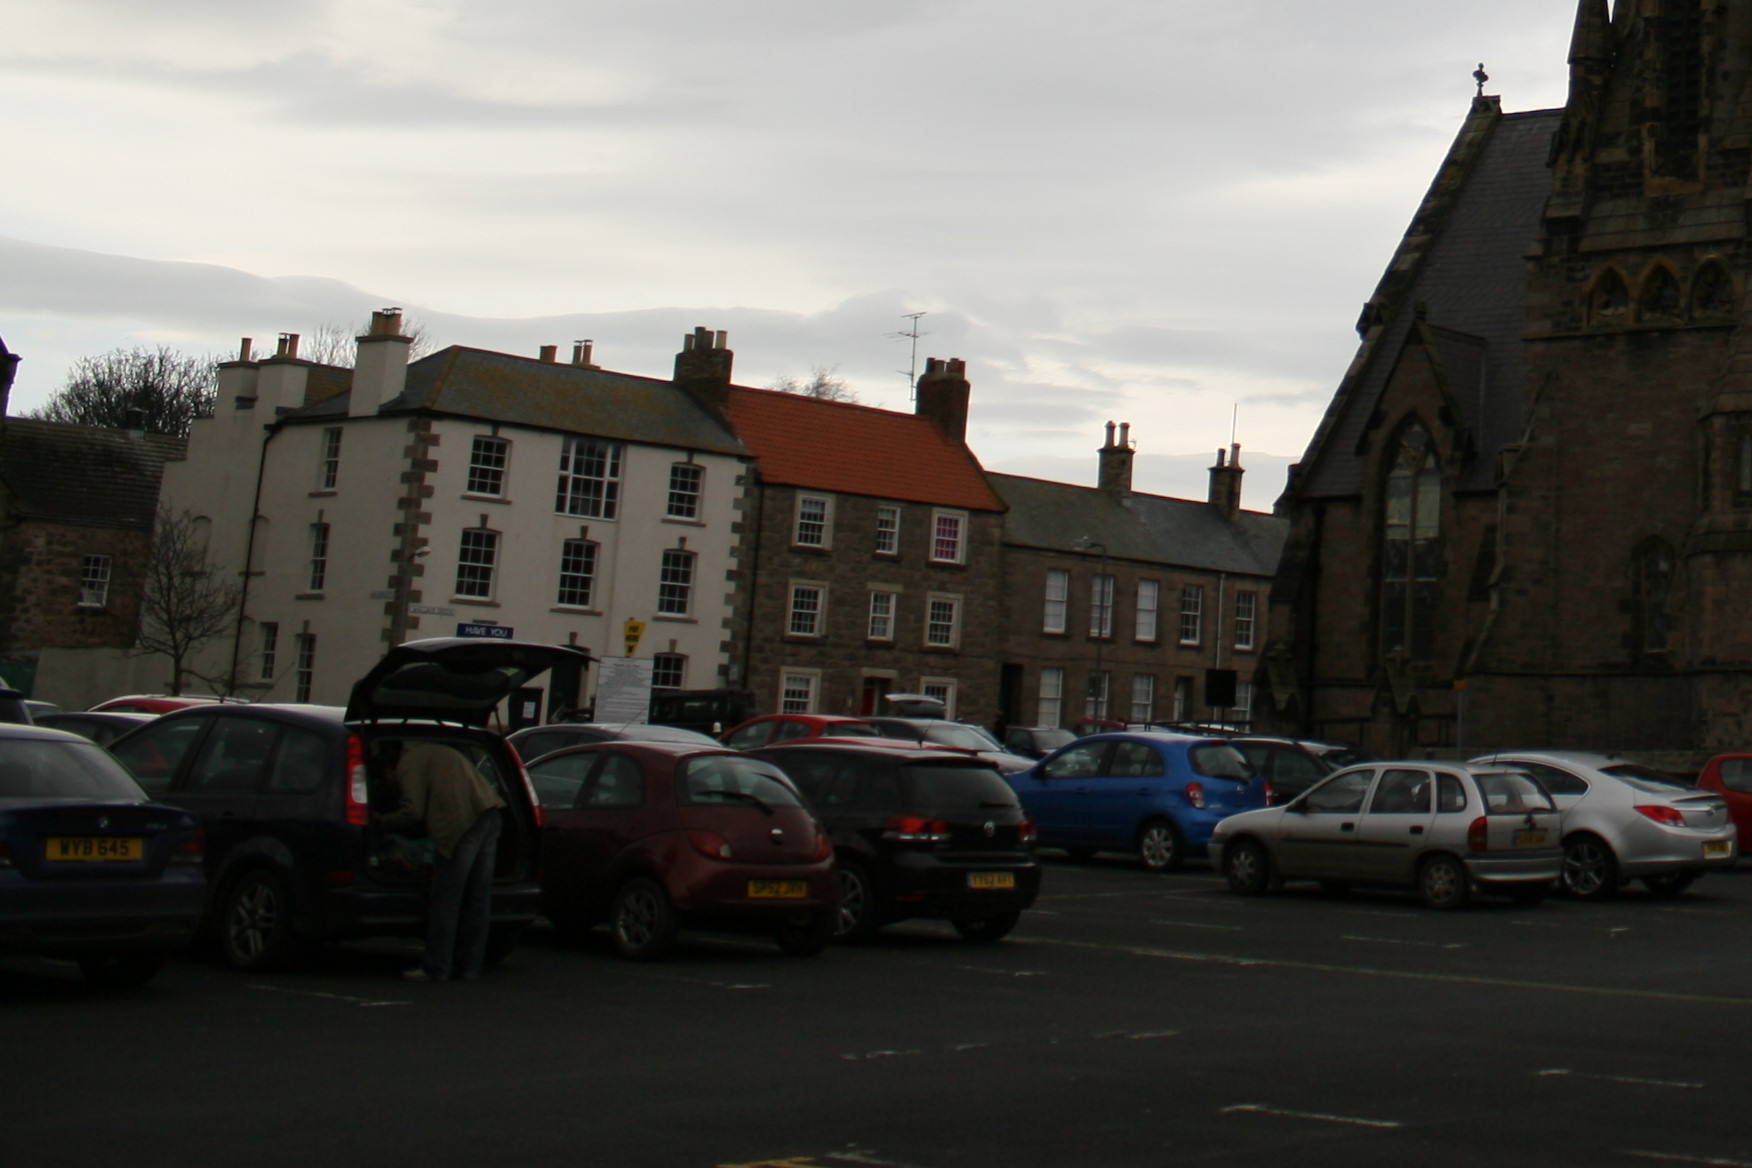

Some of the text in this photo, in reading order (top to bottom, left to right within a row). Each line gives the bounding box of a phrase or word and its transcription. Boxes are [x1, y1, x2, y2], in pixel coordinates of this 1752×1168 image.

[464, 625, 508, 638] HAVE YOU
[60, 839, 130, 856] WYB 645
